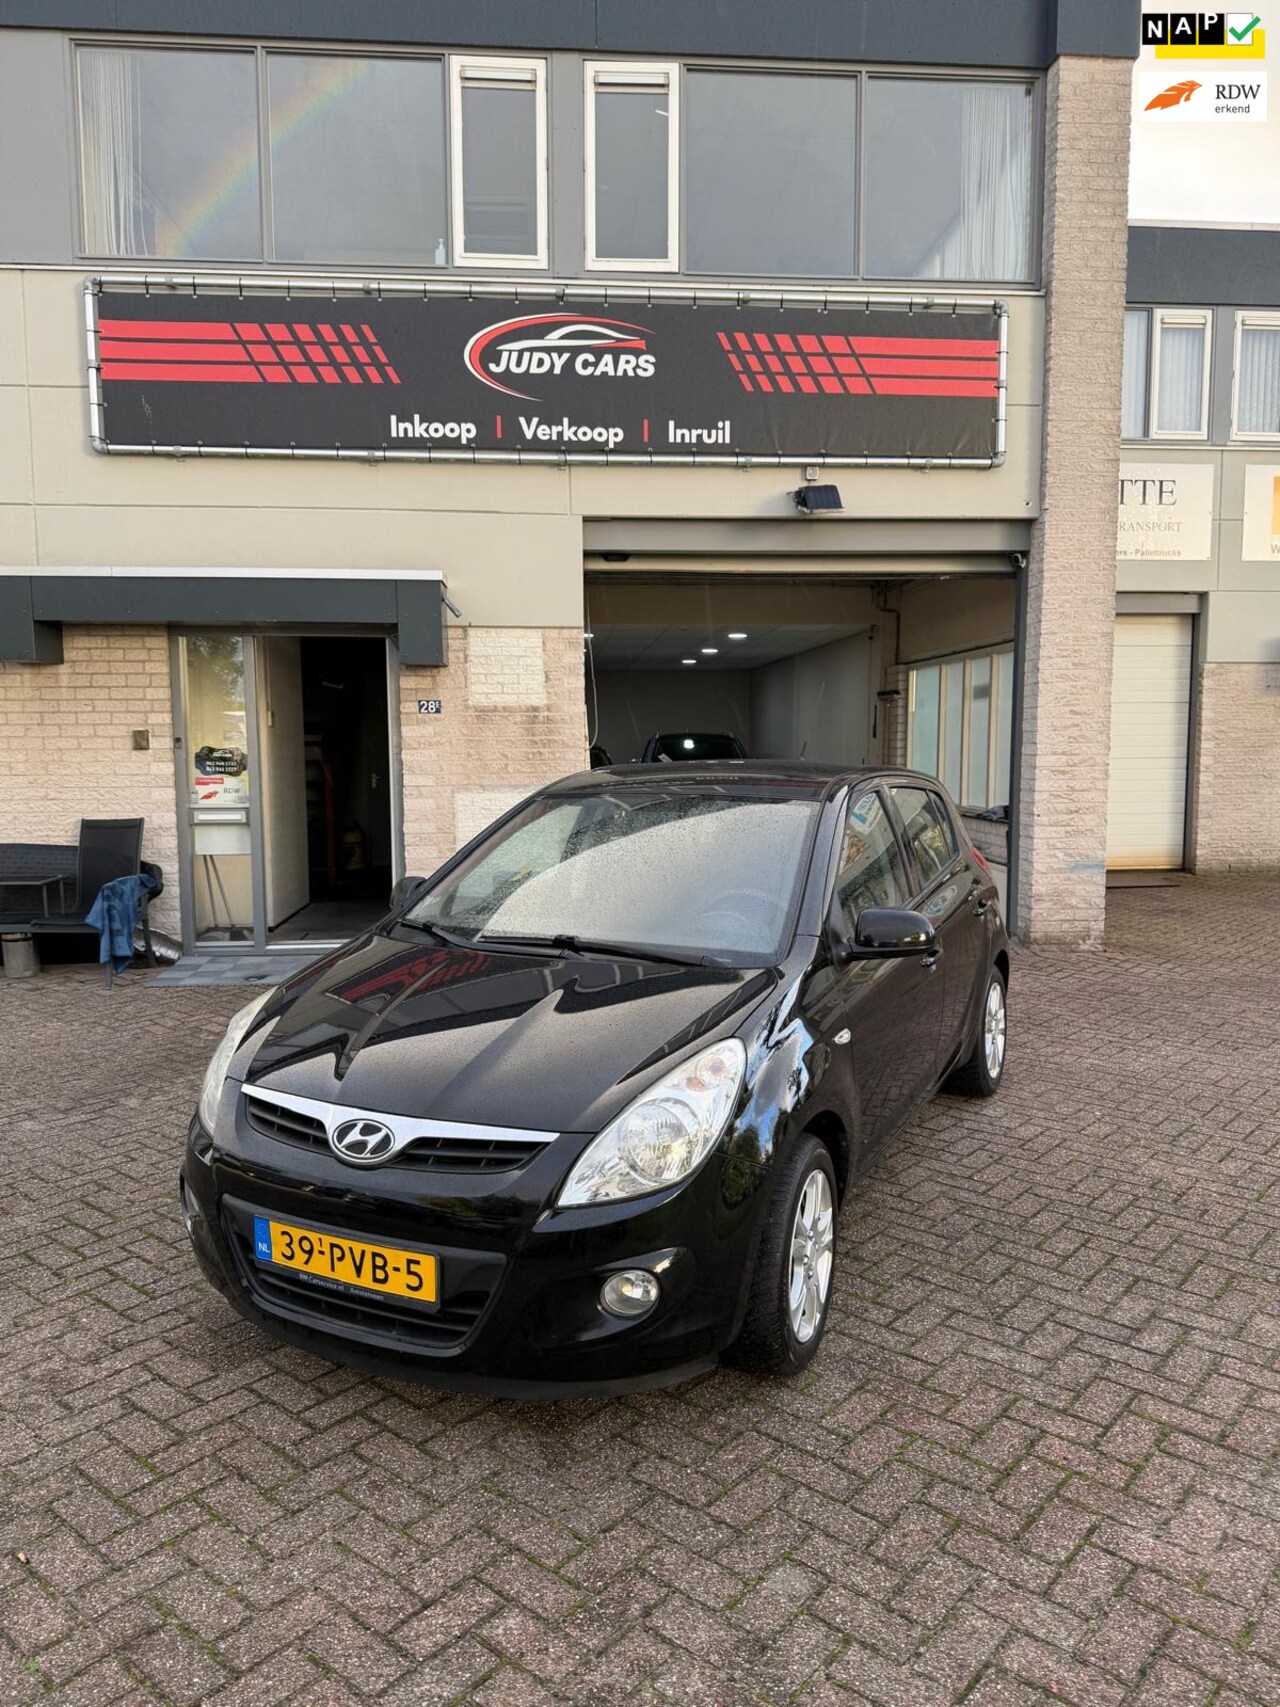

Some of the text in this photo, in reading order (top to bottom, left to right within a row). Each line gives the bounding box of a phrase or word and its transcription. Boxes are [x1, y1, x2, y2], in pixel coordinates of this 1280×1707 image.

[488, 351, 657, 378] JUDY CARS
[390, 414, 731, 448] Inkoop Verkoop Inruil
[258, 1242, 271, 1253] NL
